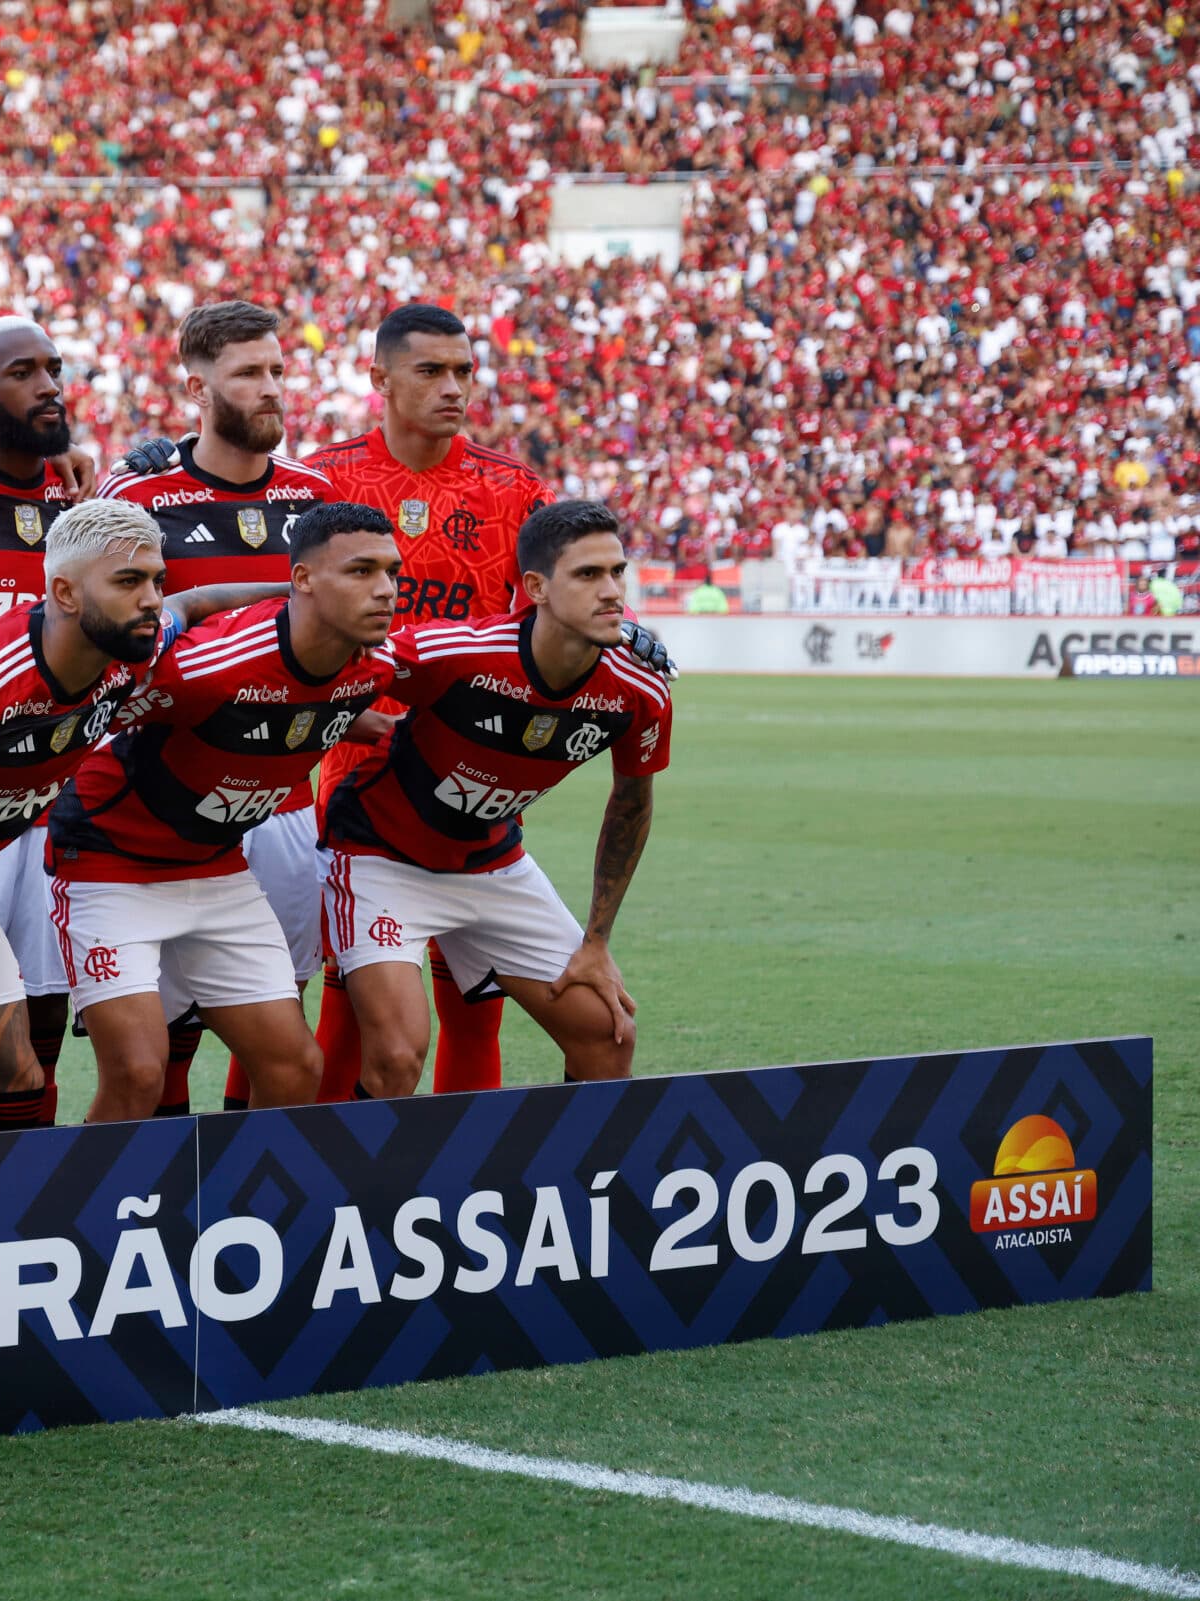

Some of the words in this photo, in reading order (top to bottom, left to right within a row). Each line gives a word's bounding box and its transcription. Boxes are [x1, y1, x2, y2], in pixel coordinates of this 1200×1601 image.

[152, 487, 216, 511] pixbet
[266, 485, 314, 504] pixbet
[394, 576, 474, 621] BRB
[1073, 654, 1177, 675] APOSTA
[234, 685, 290, 704] pixbet
[330, 678, 376, 703] pixbet
[470, 673, 533, 703] pixbet
[570, 692, 625, 713] pixbet
[222, 775, 260, 788] banco
[456, 761, 499, 783] banco
[983, 1174, 1085, 1225] ASSAÍ
[311, 1170, 619, 1310] ASSAÍ
[649, 1146, 941, 1272] 2023
[994, 1228, 1072, 1250] ATACADISTA
